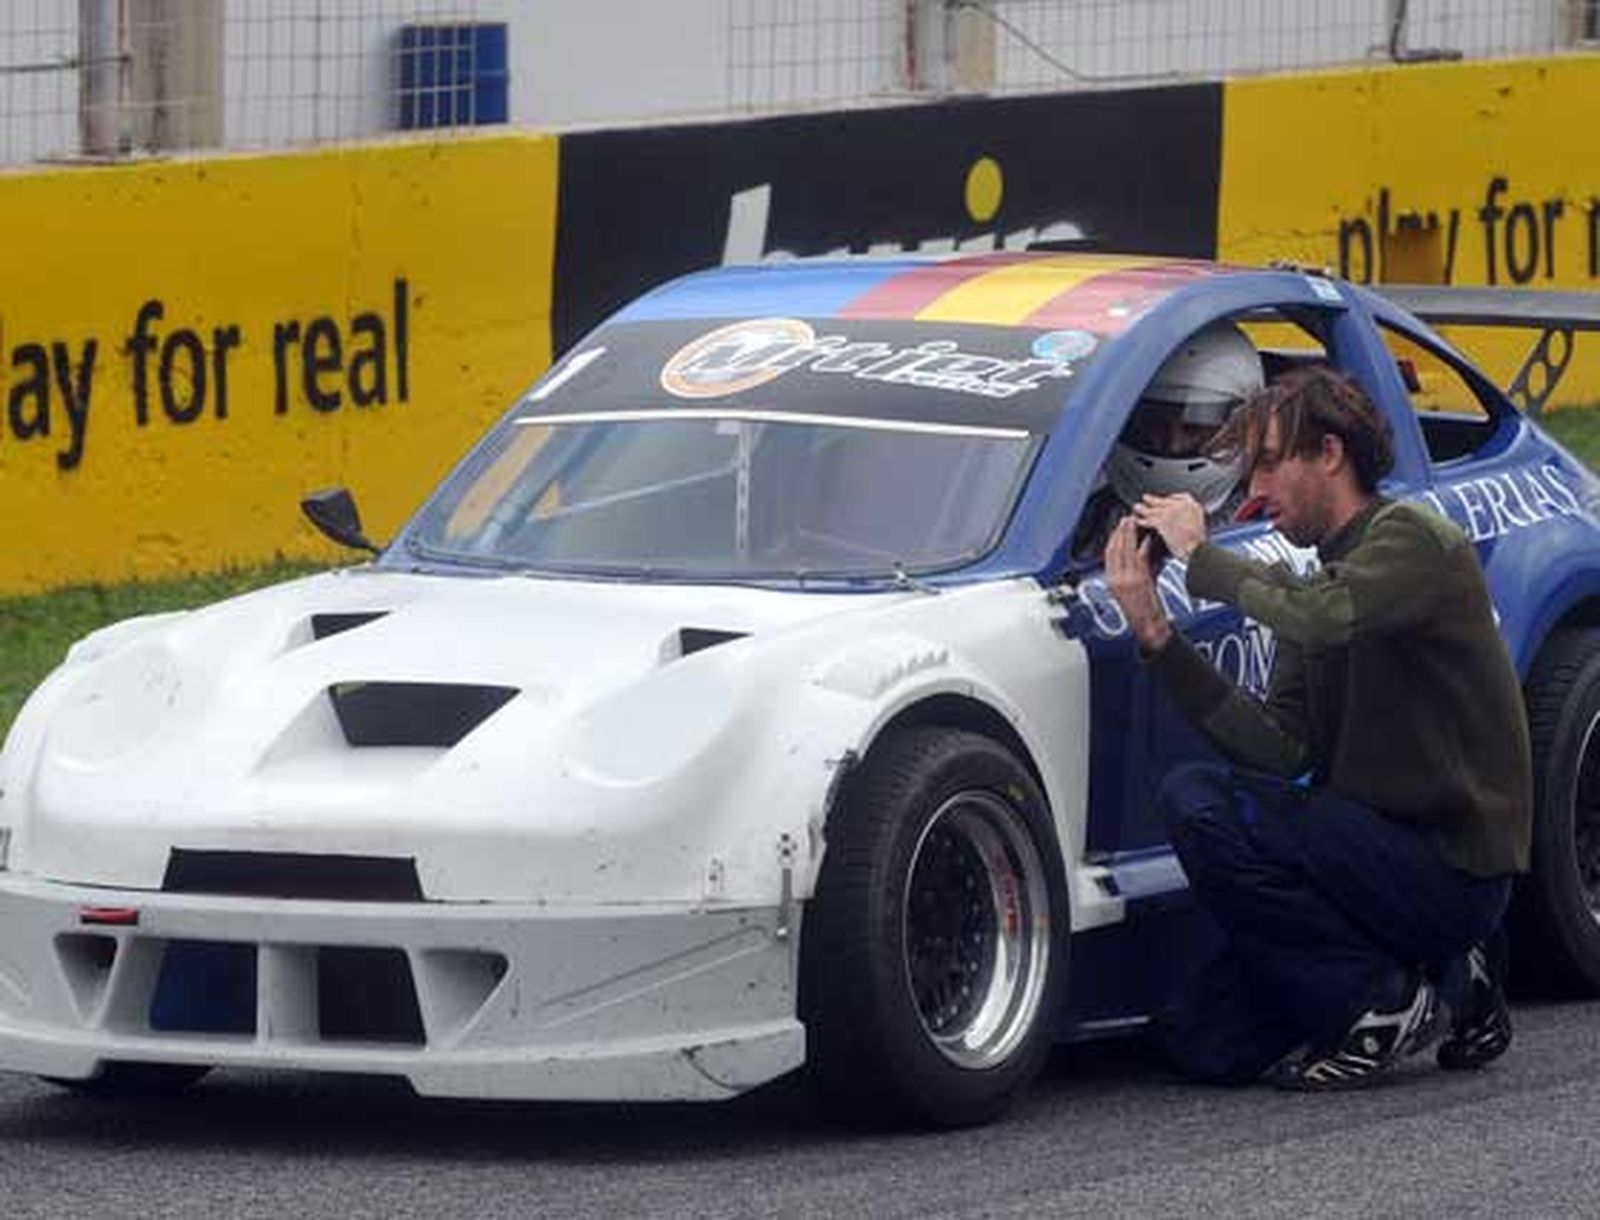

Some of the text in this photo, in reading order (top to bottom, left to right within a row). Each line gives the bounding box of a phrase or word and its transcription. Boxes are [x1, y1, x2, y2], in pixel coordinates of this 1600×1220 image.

[1478, 177, 1564, 286] for
[0, 278, 410, 471] ay for real
